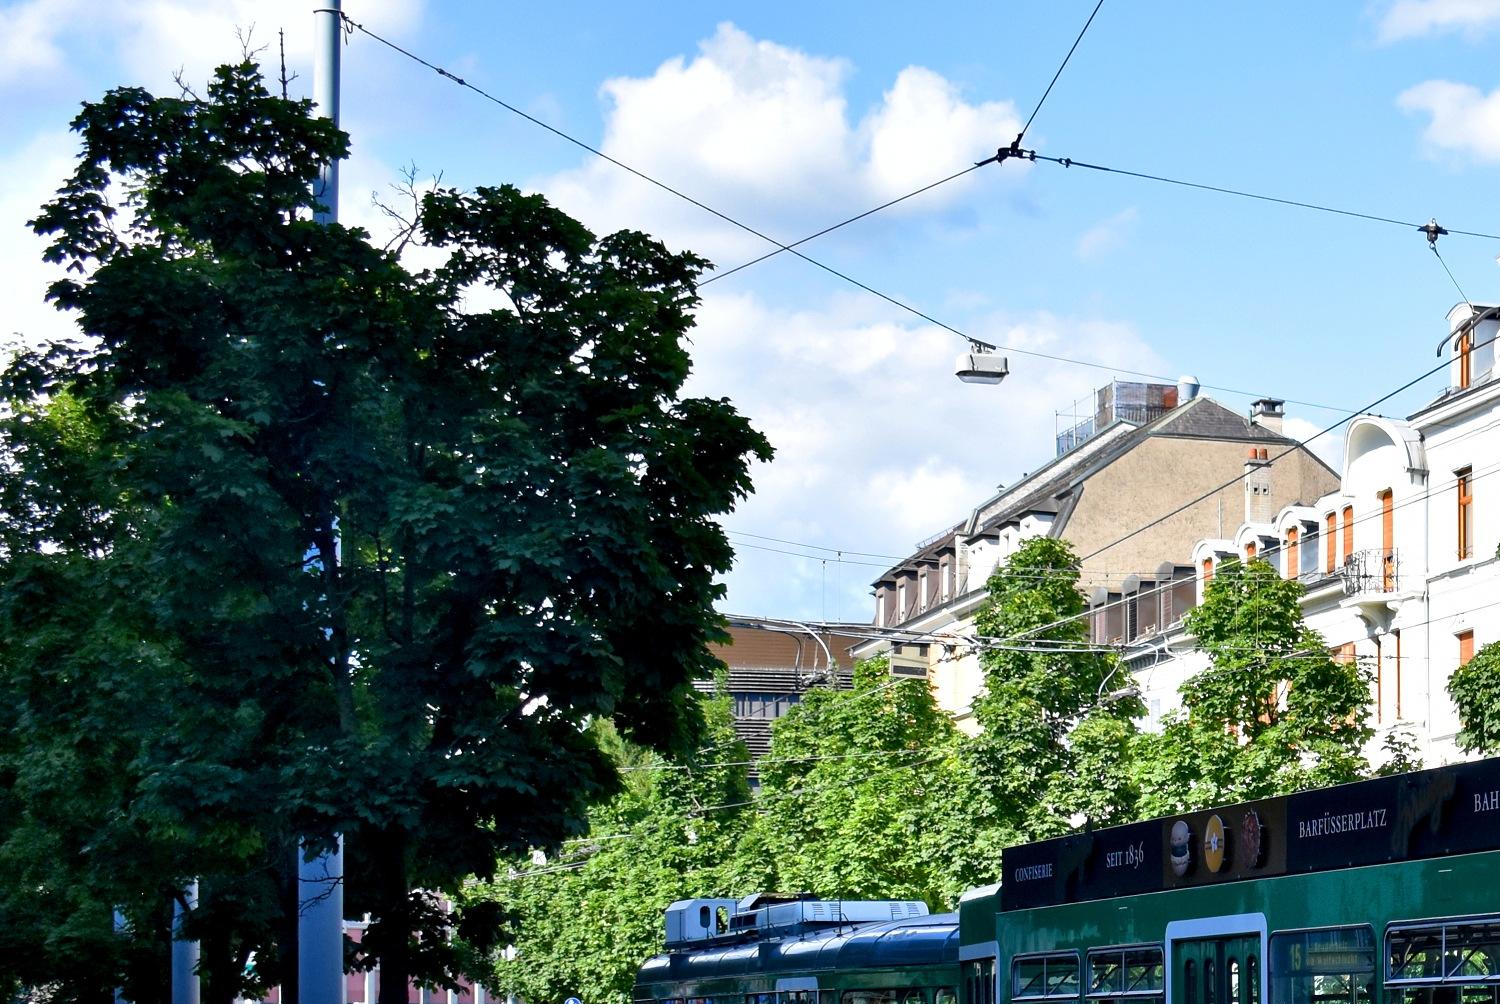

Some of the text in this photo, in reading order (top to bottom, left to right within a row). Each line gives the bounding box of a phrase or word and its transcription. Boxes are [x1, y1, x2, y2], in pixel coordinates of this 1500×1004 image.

[1299, 808, 1387, 839] BARFÜSSERPLATZ
[1106, 841, 1144, 870] SEIT 1836
[1015, 863, 1053, 882] CONFISERIE
[1290, 943, 1301, 970] 15
